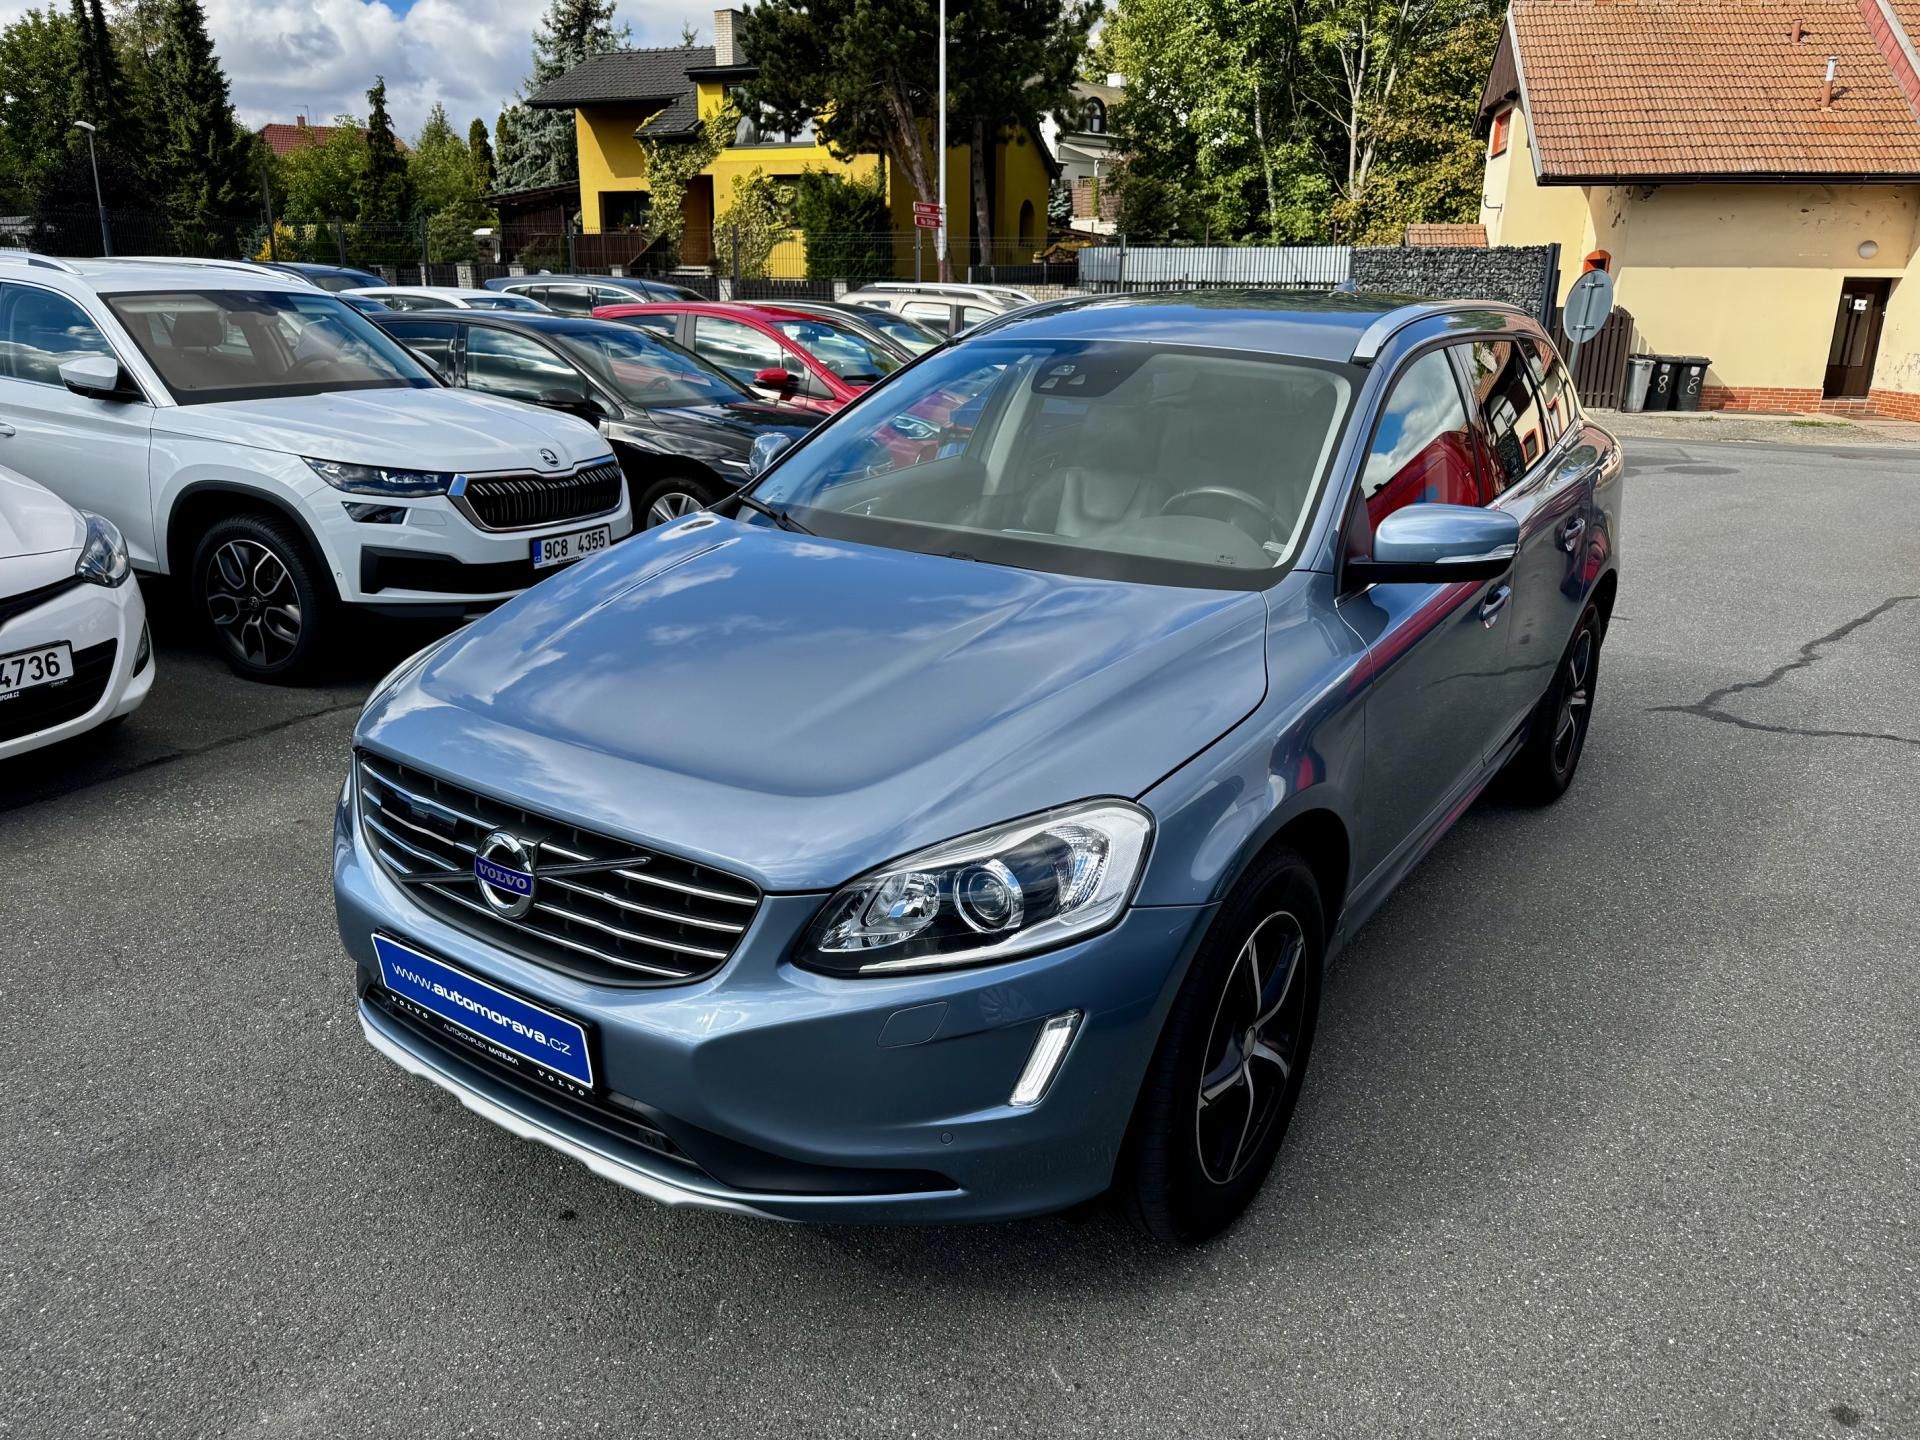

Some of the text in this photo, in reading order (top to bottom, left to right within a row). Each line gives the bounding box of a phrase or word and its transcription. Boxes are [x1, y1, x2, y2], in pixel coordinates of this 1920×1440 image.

[1657, 374, 1669, 394] 8
[1687, 376, 1700, 394] 8
[544, 530, 605, 560] 9C8 4355
[478, 862, 527, 890] VOLVO
[391, 995, 428, 1019] VOLVO
[391, 962, 572, 1057] www.automorava.cz
[443, 1023, 487, 1050] AUTOKOMPLEX
[537, 1069, 585, 1097] VOLVO
